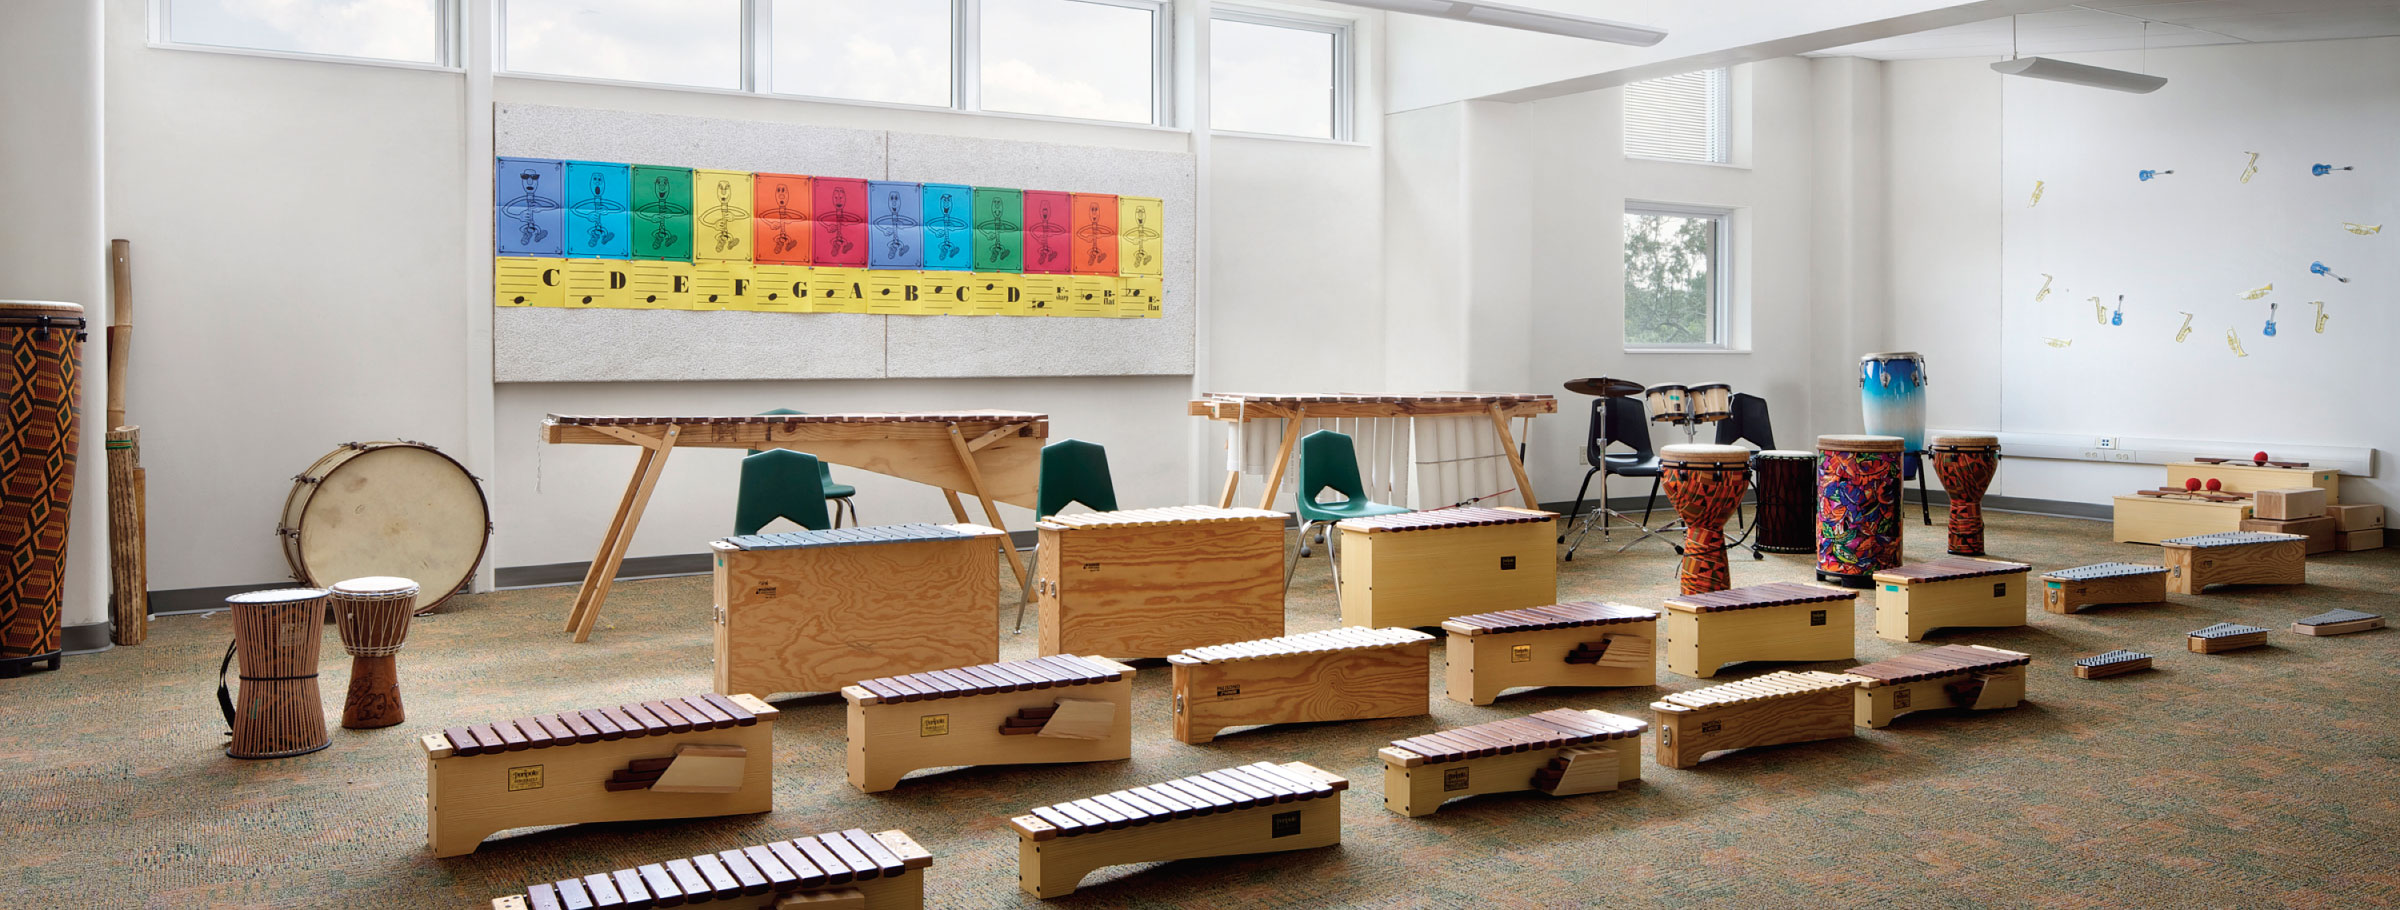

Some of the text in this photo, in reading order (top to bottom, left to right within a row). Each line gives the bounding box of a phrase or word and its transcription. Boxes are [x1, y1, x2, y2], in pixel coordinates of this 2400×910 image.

[542, 268, 560, 287] C
[610, 271, 627, 290] D
[673, 275, 689, 293] E
[735, 278, 750, 295] F
[792, 281, 807, 298] G
[849, 283, 863, 299] A
[905, 285, 919, 301] B
[956, 286, 970, 302] C
[1007, 287, 1020, 302] D
[1103, 290, 1116, 298] B-
[1056, 294, 1069, 303] sharp
[1103, 297, 1116, 305] flat
